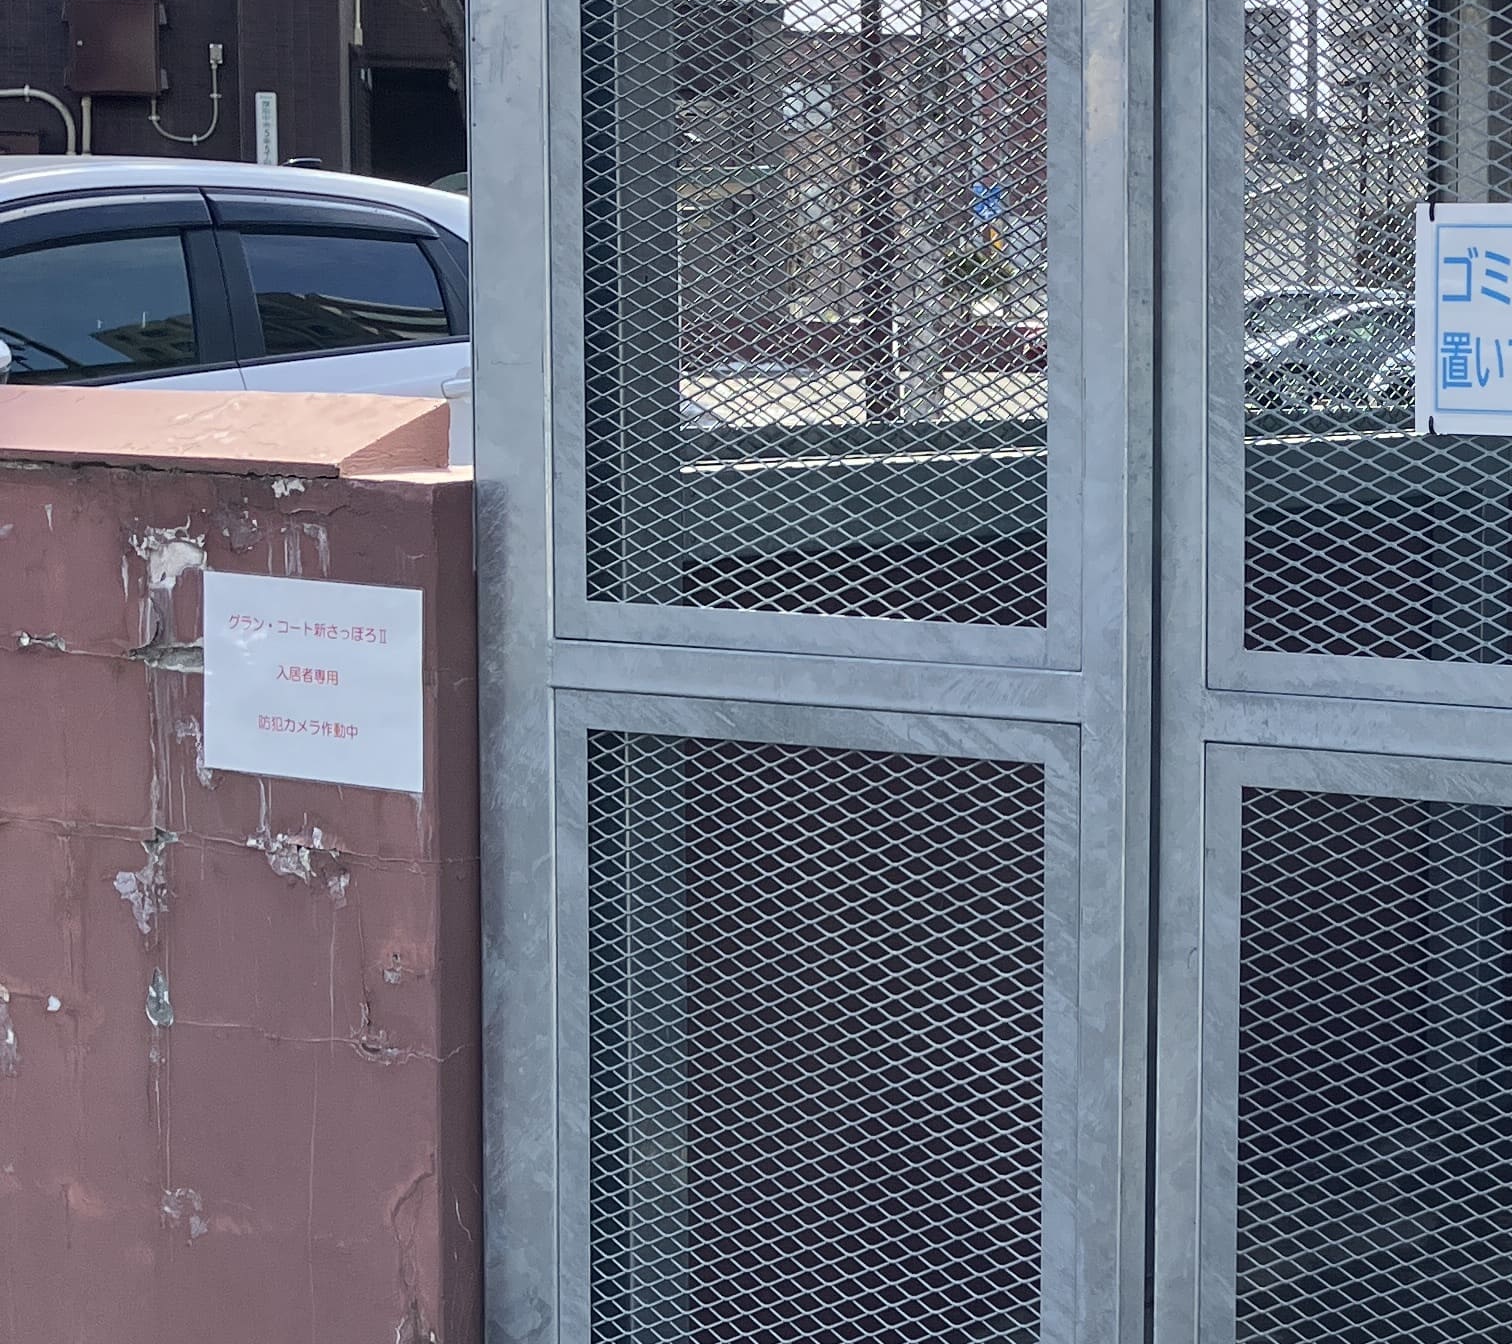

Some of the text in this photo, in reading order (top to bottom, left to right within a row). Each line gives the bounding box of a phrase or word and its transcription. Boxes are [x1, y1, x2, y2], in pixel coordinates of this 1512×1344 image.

[276, 665, 339, 686] 入居者専用
[258, 715, 359, 740] 防犯カメラ作動中
